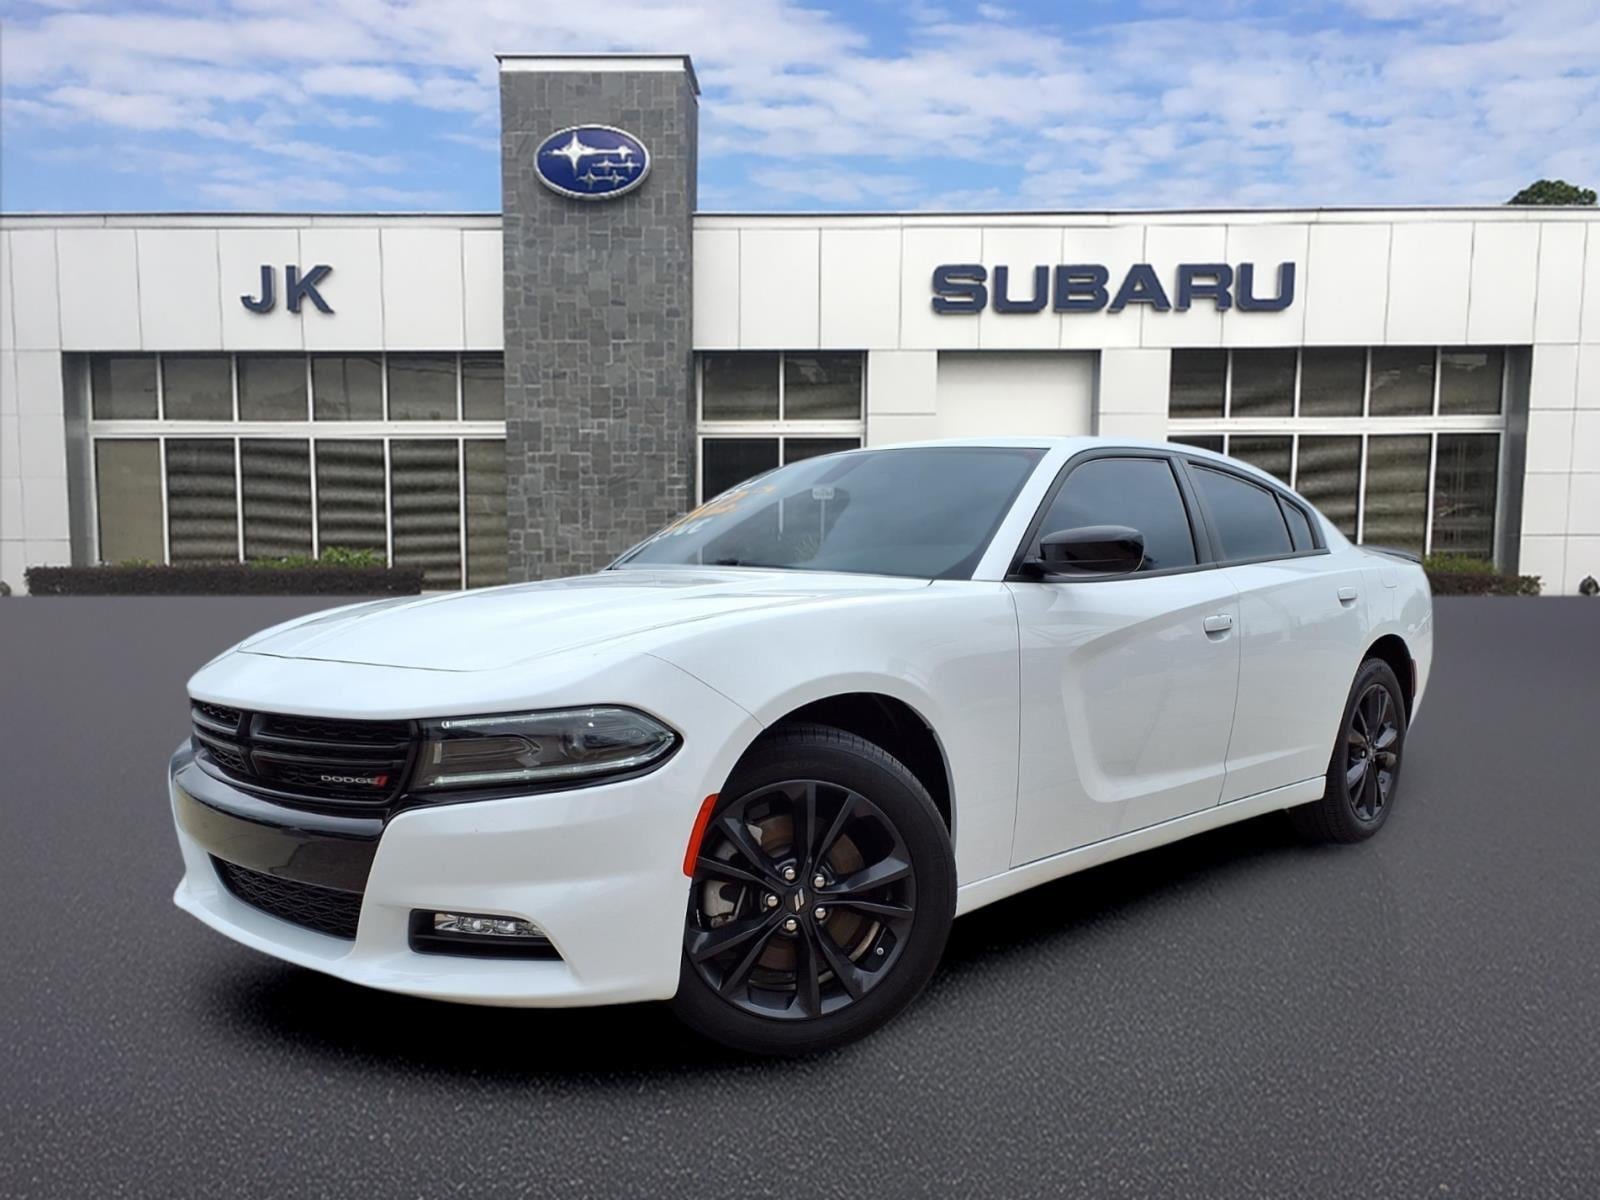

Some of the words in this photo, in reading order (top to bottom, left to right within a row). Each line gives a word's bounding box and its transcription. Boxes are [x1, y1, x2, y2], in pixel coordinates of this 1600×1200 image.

[240, 264, 335, 314] JK
[931, 262, 1296, 315] SUBARU
[320, 774, 379, 785] DODGE
